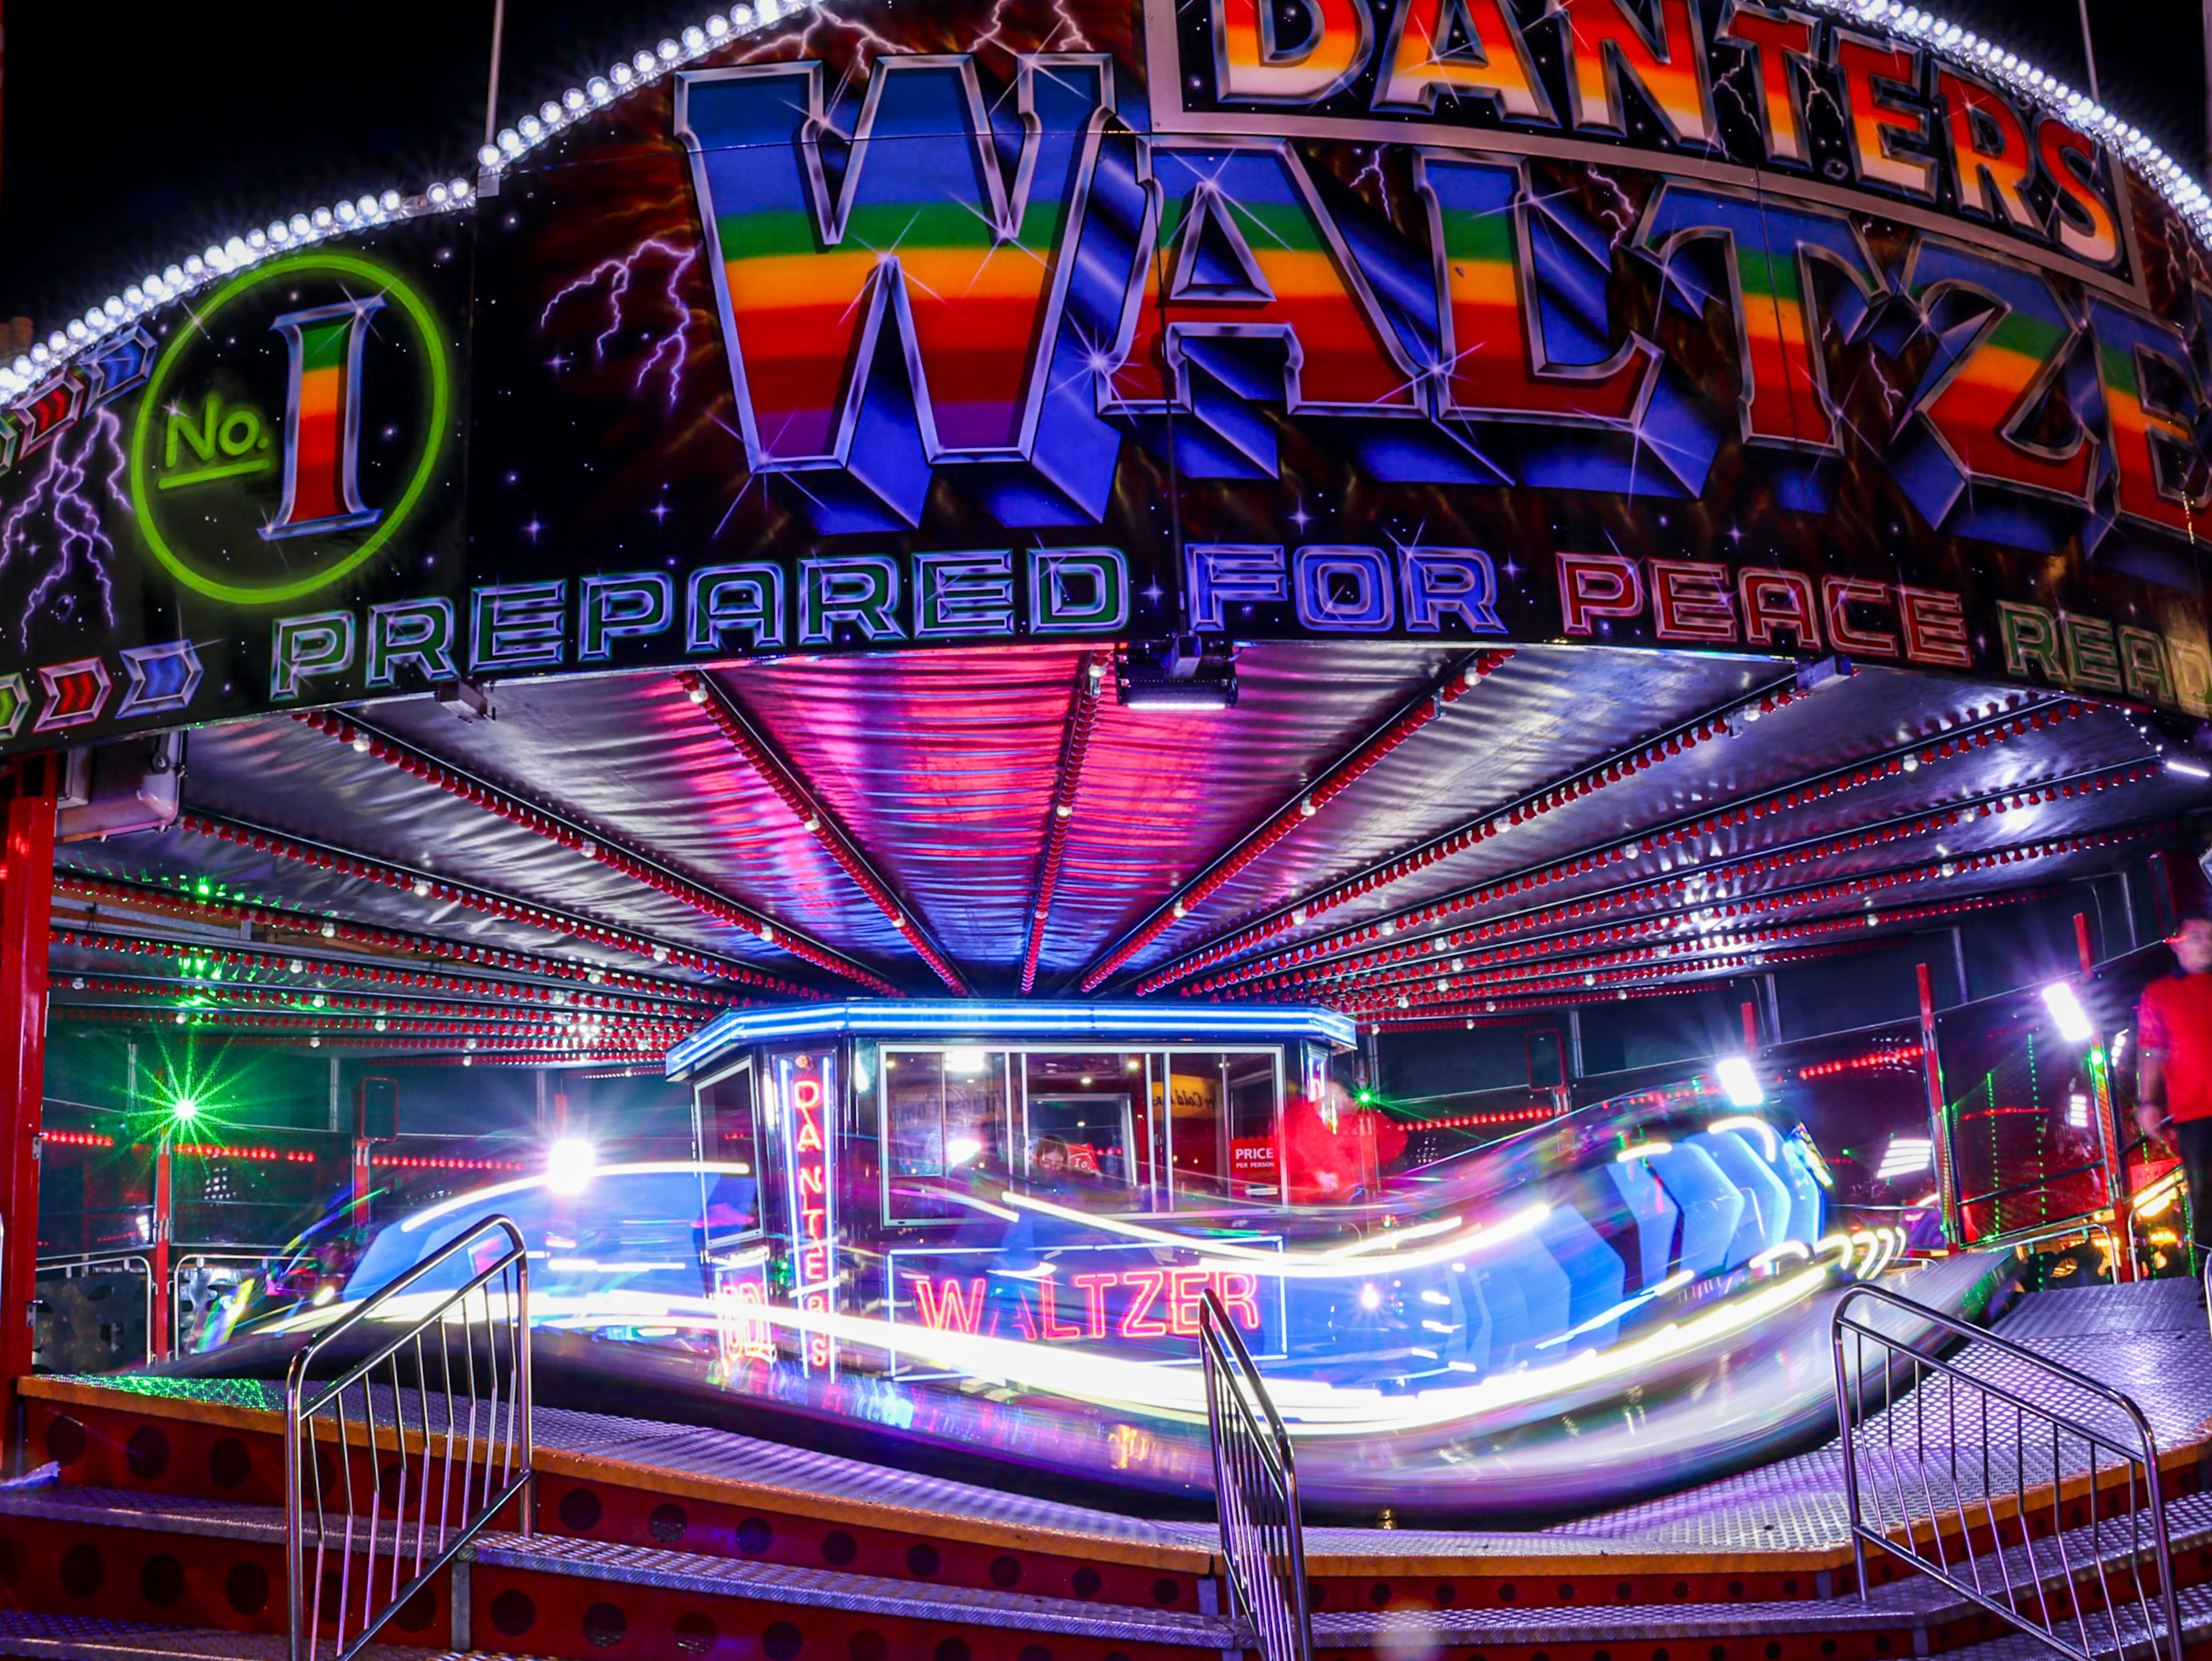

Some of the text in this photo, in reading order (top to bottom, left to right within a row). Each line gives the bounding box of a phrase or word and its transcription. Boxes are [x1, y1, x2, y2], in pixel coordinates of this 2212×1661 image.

[1211, 0, 2123, 269] DANTERS
[673, 50, 2212, 544] WALTZE
[268, 542, 2212, 718] PREPARED FOR PEACE READ
[1235, 1147, 1274, 1160] PRICE
